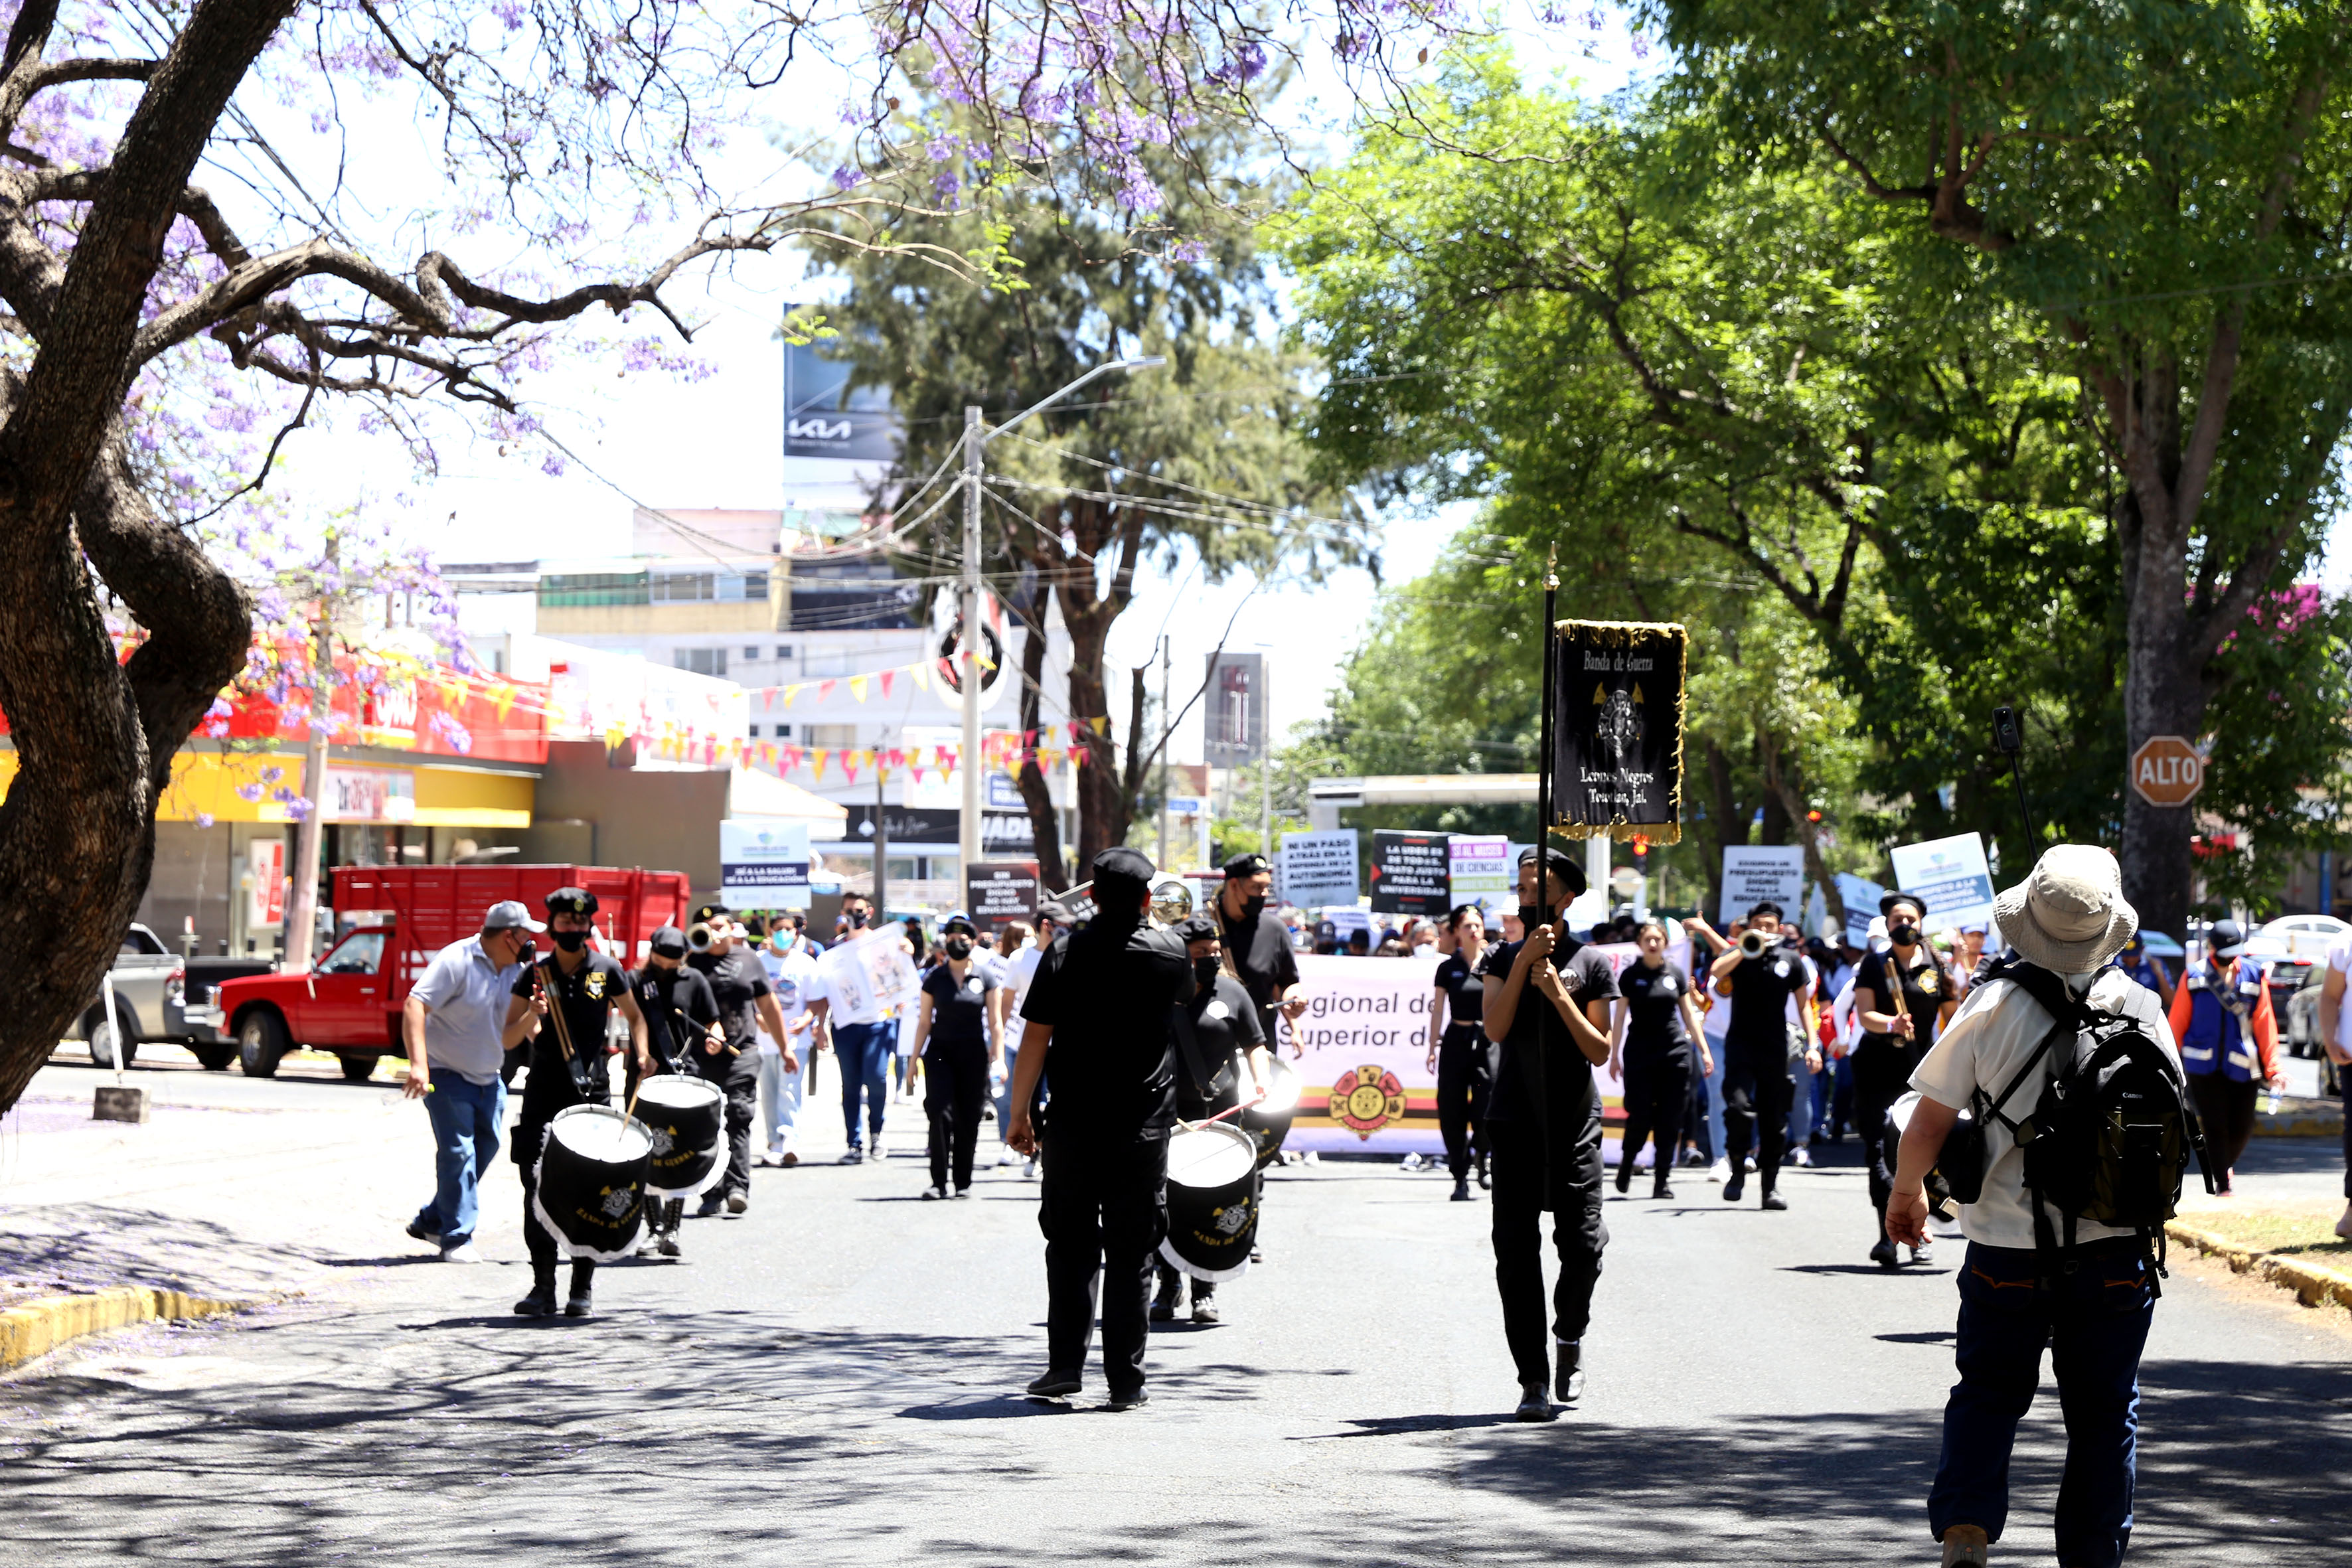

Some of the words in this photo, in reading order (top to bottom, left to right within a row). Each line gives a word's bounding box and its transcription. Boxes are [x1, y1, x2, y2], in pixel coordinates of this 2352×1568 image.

[788, 418, 852, 439] KIA
[1583, 650, 1610, 670] Banda
[1614, 651, 1624, 671] de
[1627, 651, 1653, 671] Guerra
[2139, 757, 2197, 785] ALTO
[1580, 767, 1618, 783] Leones
[1620, 767, 1654, 788] Negros
[1320, 838, 1350, 847] PASO
[1289, 850, 1320, 859] ATRÁS
[1385, 845, 1401, 855] LA
[1430, 847, 1444, 857] ES
[1474, 844, 1504, 856] MUSEO
[1387, 854, 1402, 864] DE
[747, 867, 753, 876] A
[753, 867, 766, 876] LA
[1381, 864, 1415, 875] TRATO
[1415, 866, 1447, 877] JUSTO
[1456, 862, 1464, 872] DE
[1468, 862, 1504, 872] CIENCIAS
[993, 871, 1010, 880] SIN
[1289, 869, 1352, 879] AUTONOMÍA
[737, 876, 744, 884] A
[744, 876, 756, 884] LA
[969, 879, 1035, 889] PRESUPUESTO
[1289, 881, 1352, 890] UNIVERSITARIA
[1391, 875, 1419, 885] PARA
[1420, 876, 1435, 886] LA
[1955, 880, 1962, 889] A
[1963, 878, 1978, 887] LA
[1379, 884, 1447, 896] UNIVERSIDAD
[984, 897, 1000, 905] NO
[1000, 897, 1020, 905] HAY
[1071, 901, 1086, 913] LA
[1279, 1024, 1400, 1050] Superior
[575, 1207, 605, 1227] BANDA
[1223, 1237, 1234, 1245] DE
